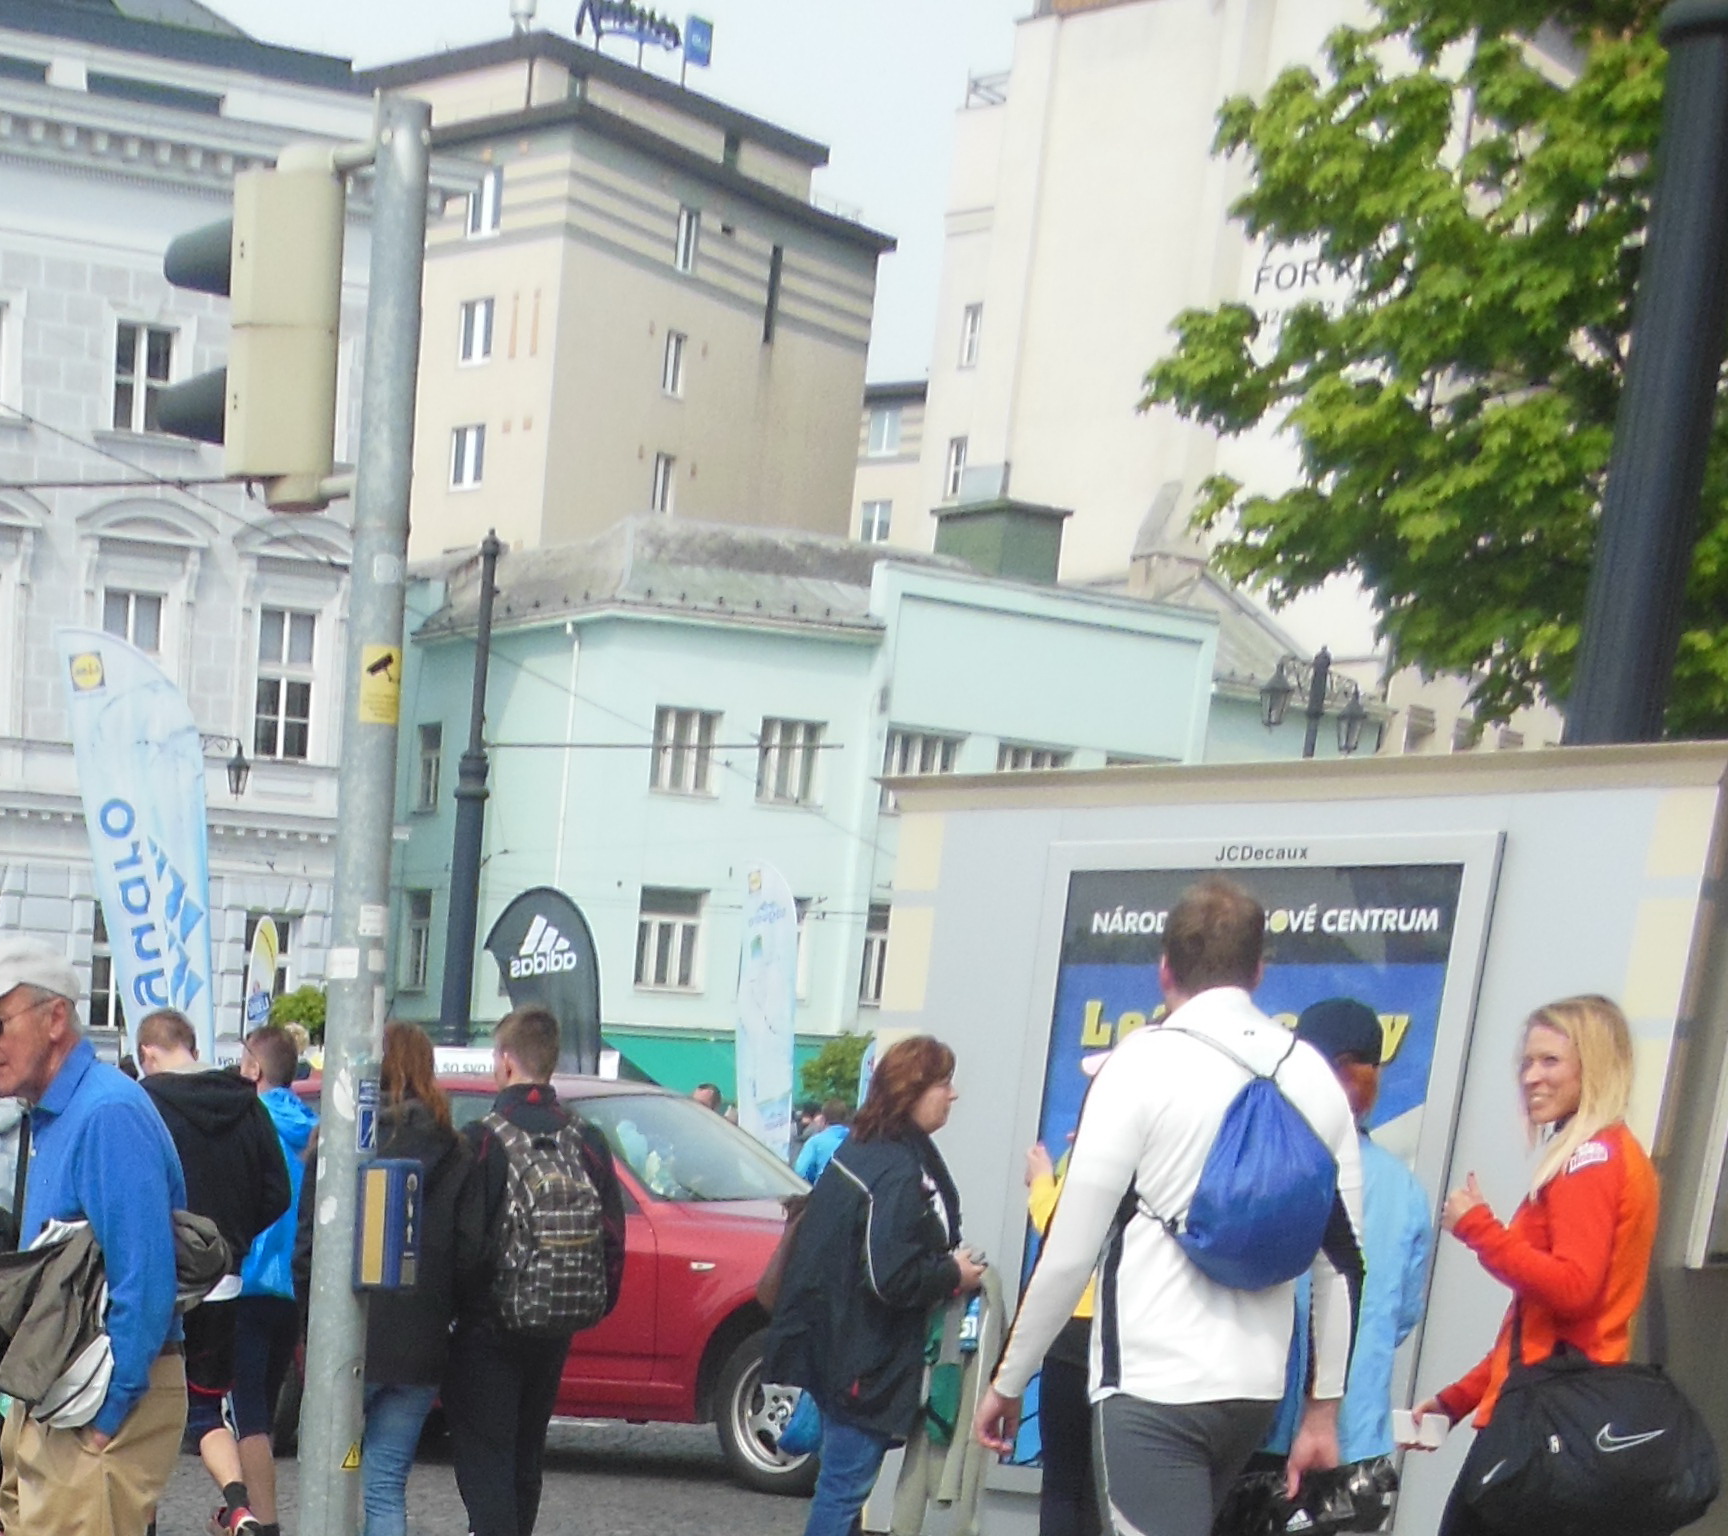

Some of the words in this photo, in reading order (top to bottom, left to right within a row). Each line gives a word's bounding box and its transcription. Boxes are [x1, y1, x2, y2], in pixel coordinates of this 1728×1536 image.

[1254, 259, 1319, 295] FOR
[1215, 845, 1309, 863] JCDecaux
[1092, 905, 1168, 935] NÁROD
[1321, 907, 1440, 933] CENTRUM
